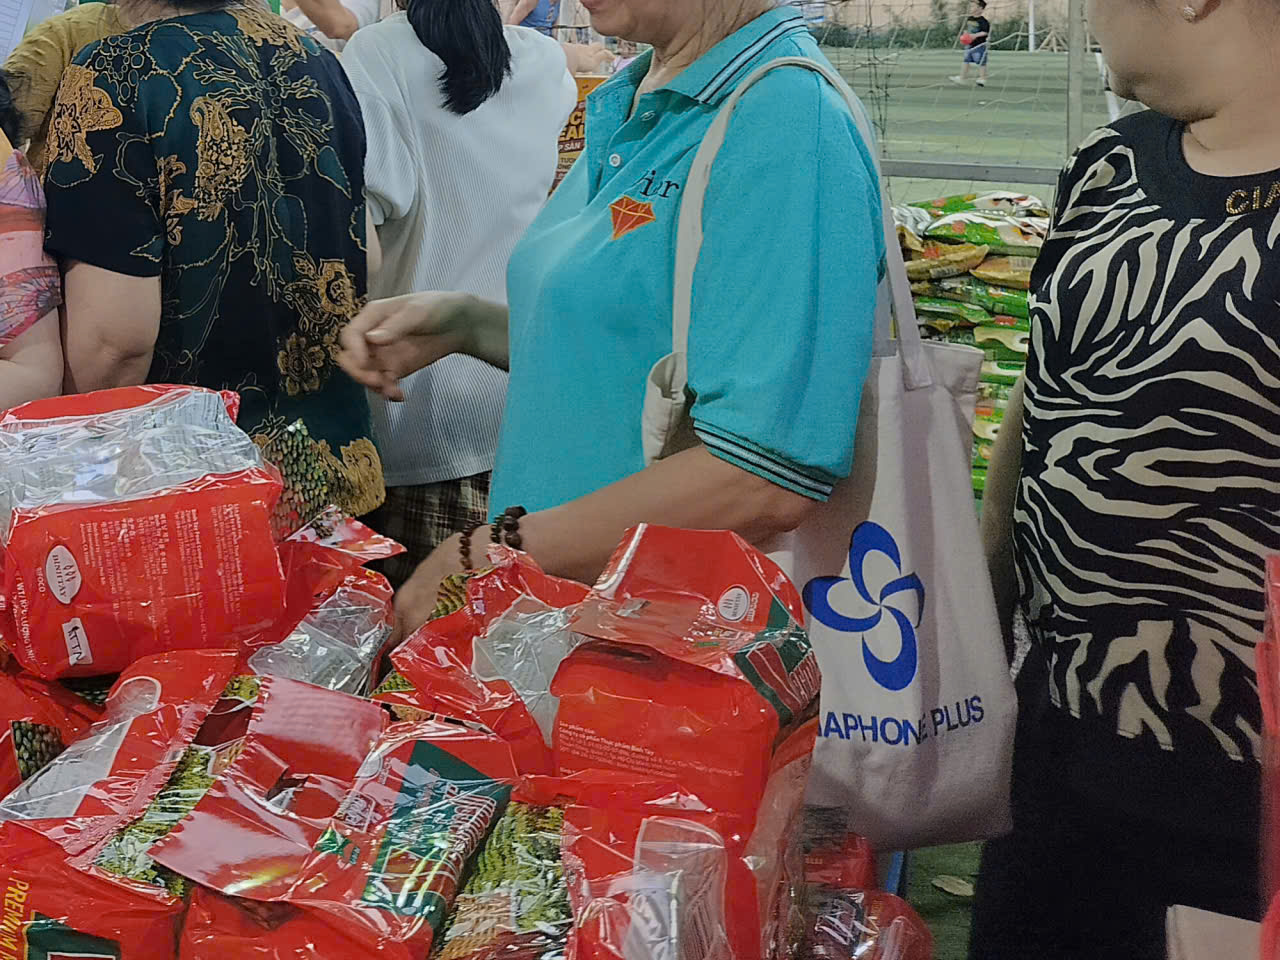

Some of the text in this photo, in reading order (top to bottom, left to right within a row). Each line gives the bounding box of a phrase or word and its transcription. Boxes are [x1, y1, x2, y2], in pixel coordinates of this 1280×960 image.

[818, 695, 985, 746] APHONE PLUS
[0, 876, 30, 951] PREMIUM
